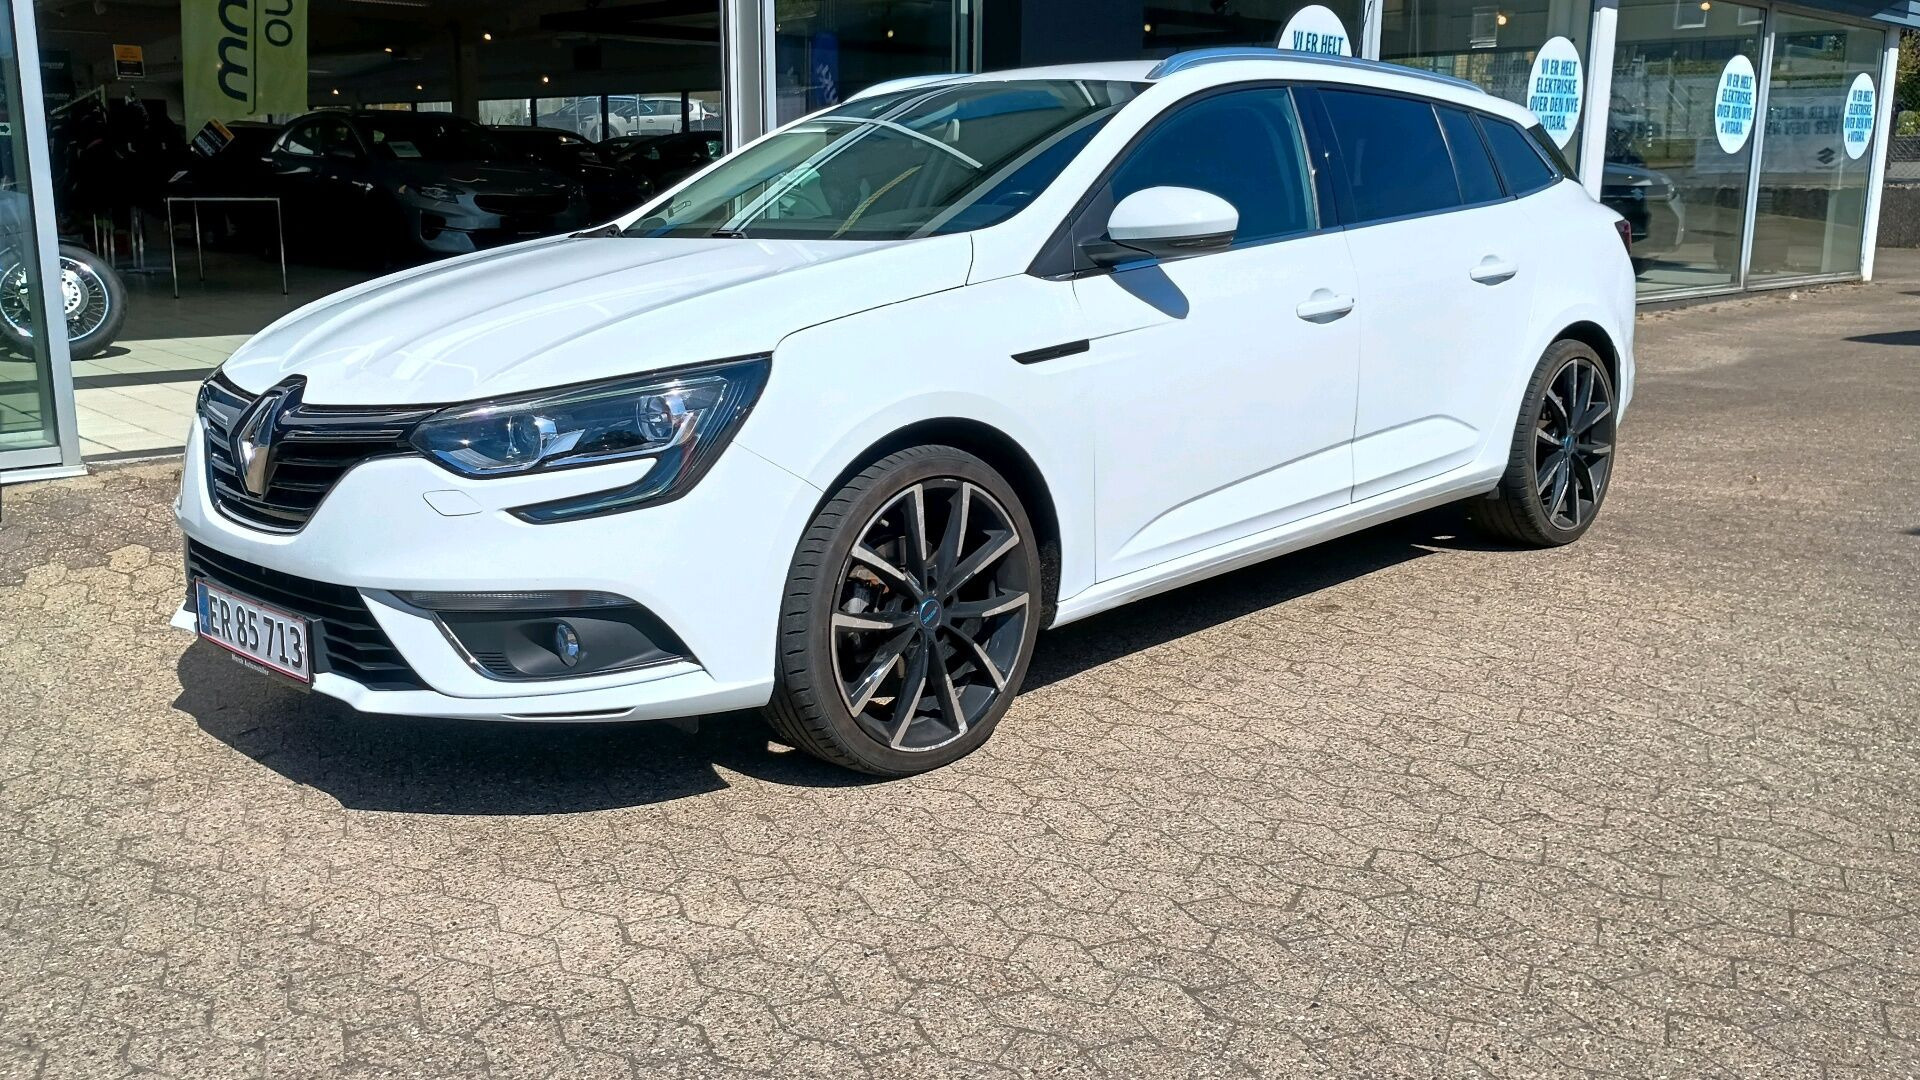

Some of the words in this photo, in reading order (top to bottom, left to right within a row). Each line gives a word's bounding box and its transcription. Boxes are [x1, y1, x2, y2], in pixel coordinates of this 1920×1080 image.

[1293, 30, 1304, 50] VI
[1306, 32, 1318, 52] ER
[1321, 34, 1344, 56] HELT
[1541, 58, 1549, 75] VI
[1550, 59, 1559, 75] ER
[1560, 60, 1577, 77] HELT
[1536, 77, 1577, 95] ELEKTRISKE
[1726, 73, 1733, 87] VI
[1733, 74, 1740, 88] ER
[1740, 75, 1753, 90] HELT
[1530, 95, 1548, 112] OVER
[1549, 97, 1564, 112] DEN
[1564, 97, 1579, 113] NYE
[1722, 89, 1752, 105] ELEKTRISKE
[1717, 104, 1731, 118] OVER
[1731, 105, 1742, 119] DEN
[1742, 106, 1752, 120] NYE
[208, 594, 234, 643] ER
[236, 605, 260, 652] 85
[263, 616, 303, 668] 713
